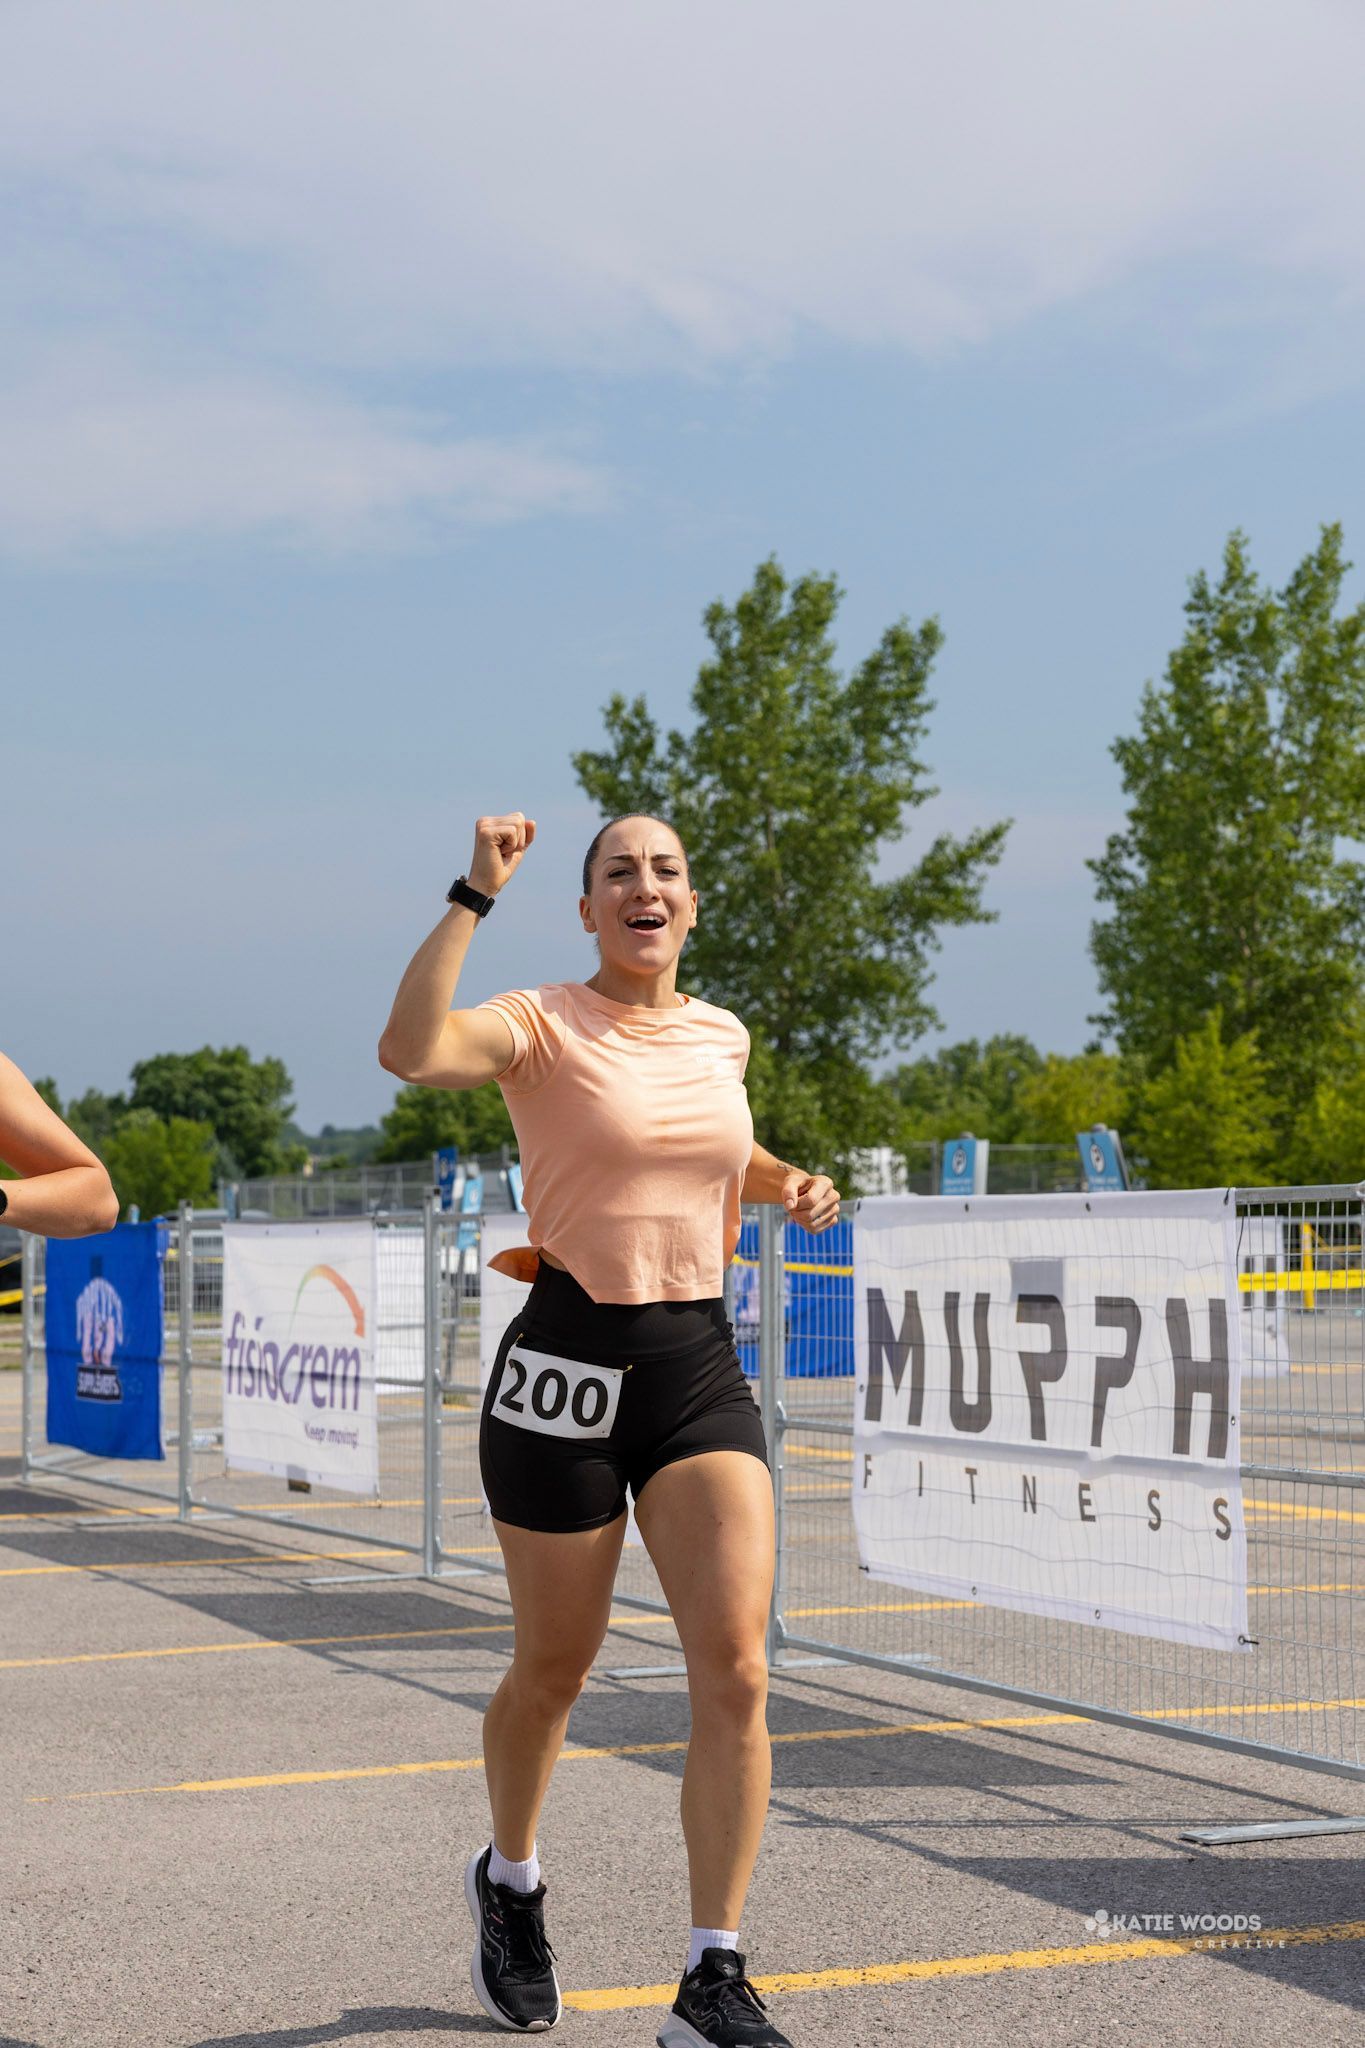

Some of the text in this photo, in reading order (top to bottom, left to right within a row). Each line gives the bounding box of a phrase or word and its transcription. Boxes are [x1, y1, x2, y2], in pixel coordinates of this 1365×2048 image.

[226, 1311, 361, 1411] fisiocrem
[500, 1359, 608, 1427] 200
[864, 1454, 1232, 1541] FITNESS
